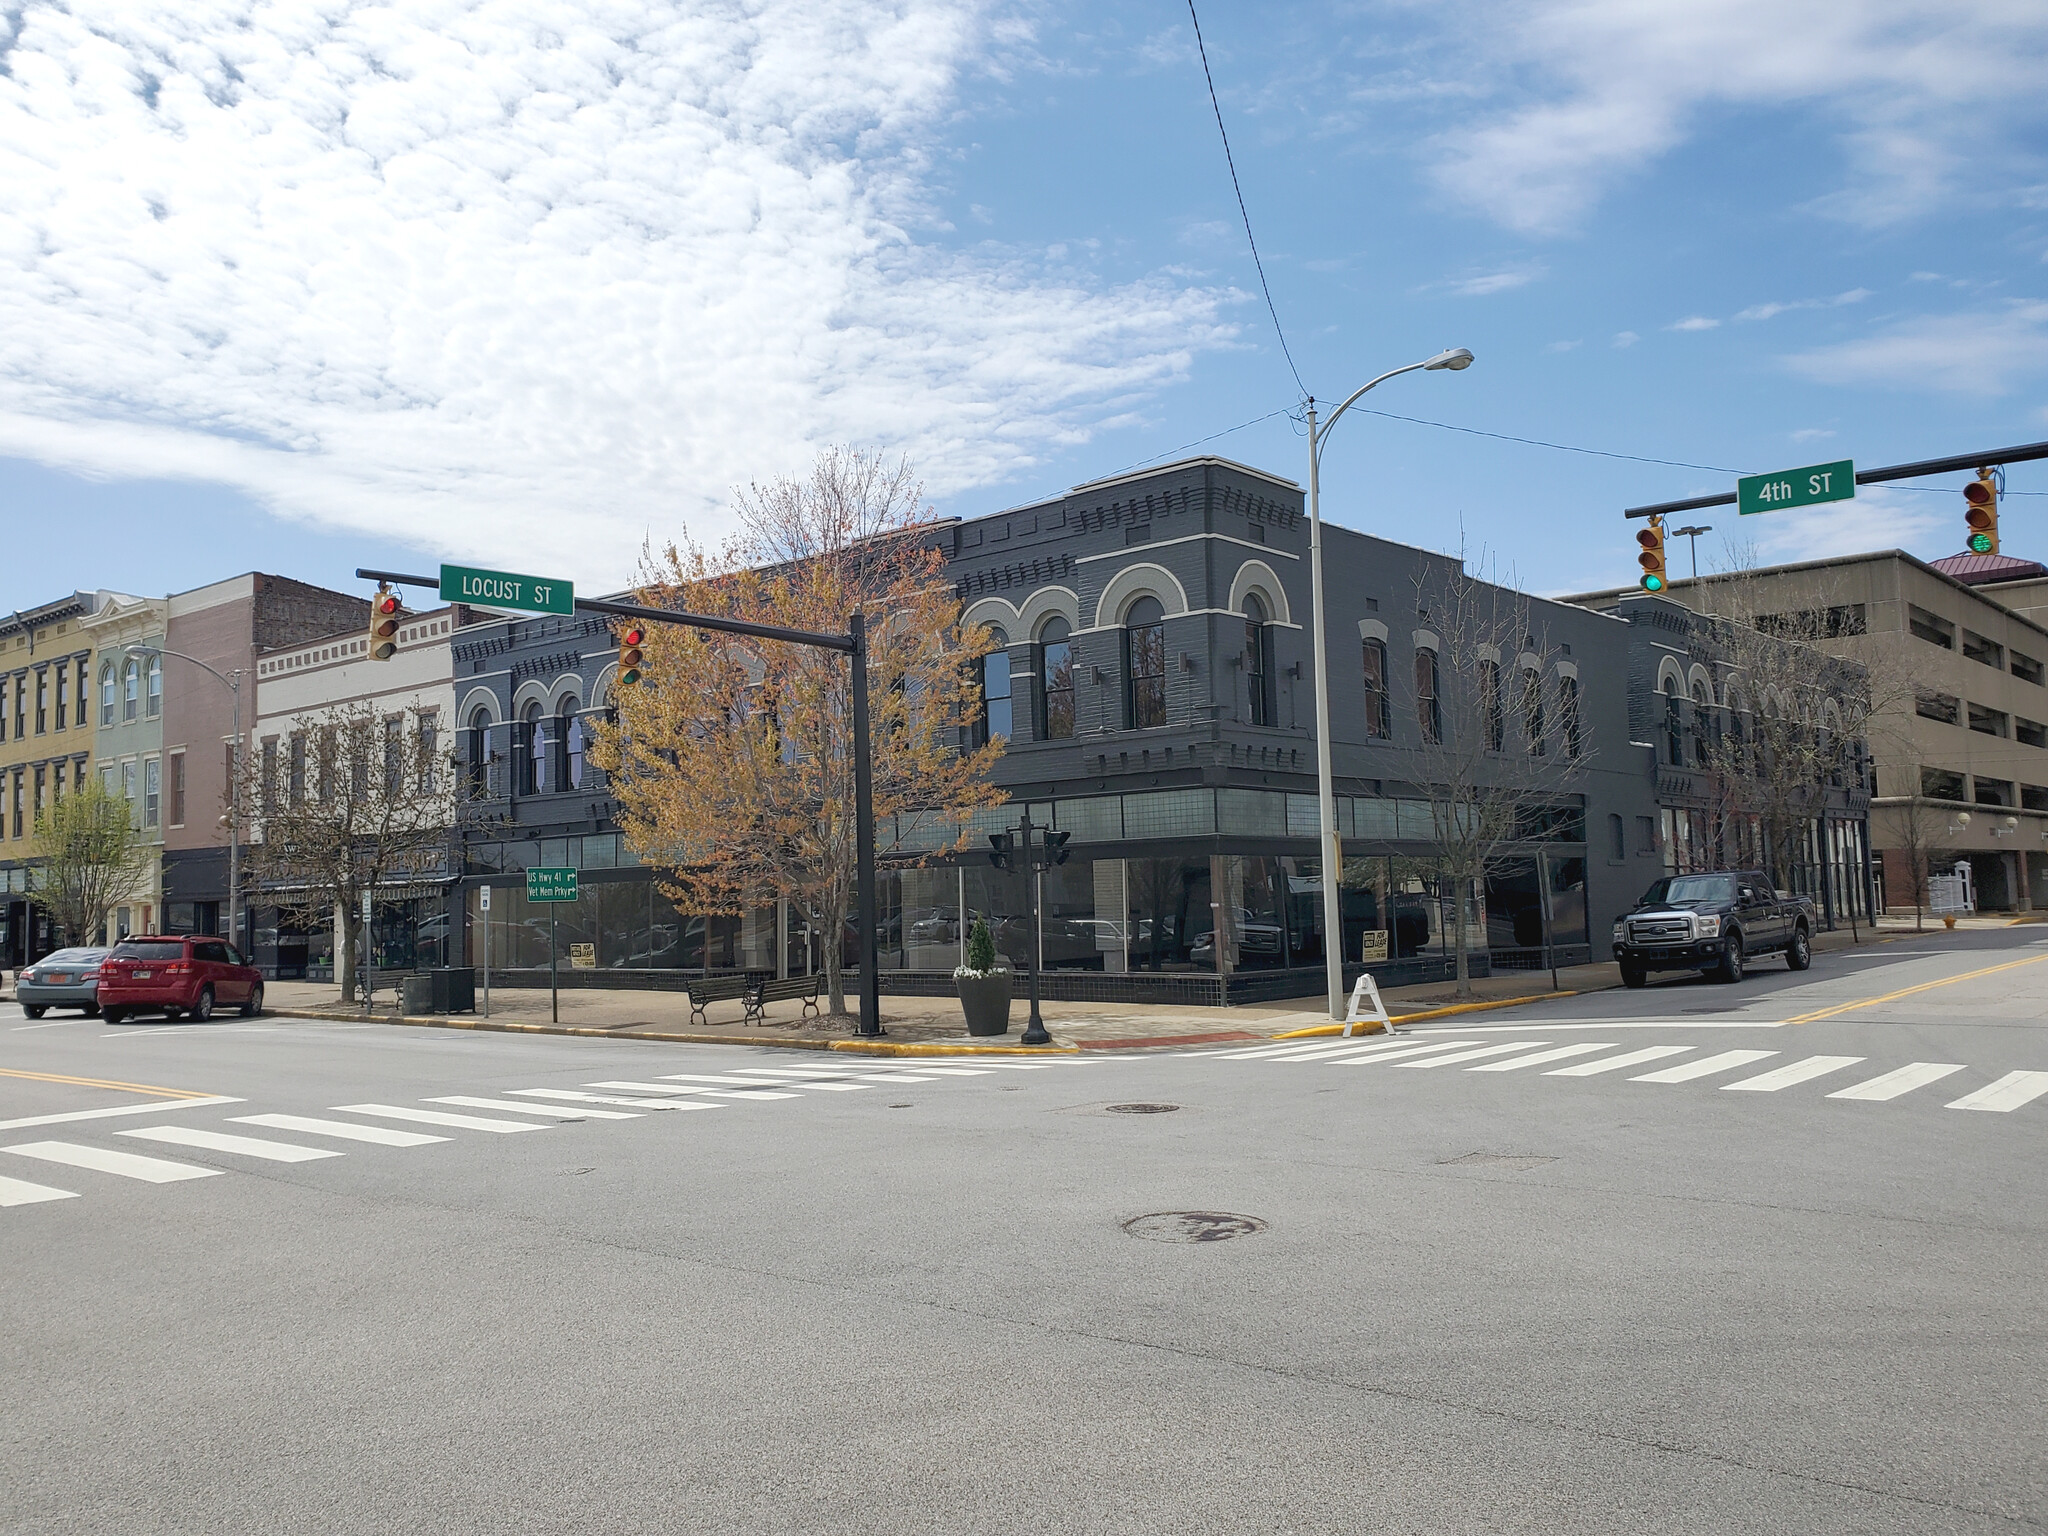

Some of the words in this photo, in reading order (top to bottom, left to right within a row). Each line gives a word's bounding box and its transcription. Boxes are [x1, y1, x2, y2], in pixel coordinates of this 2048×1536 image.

[1759, 481, 1792, 502] 4th
[1808, 472, 1832, 495] ST
[463, 576, 521, 601] LOCUST
[534, 586, 552, 604] ST
[528, 872, 537, 882] US
[539, 872, 553, 885] Hwy
[554, 872, 562, 882] 41
[528, 886, 539, 897] Vet
[539, 886, 553, 897] Mem
